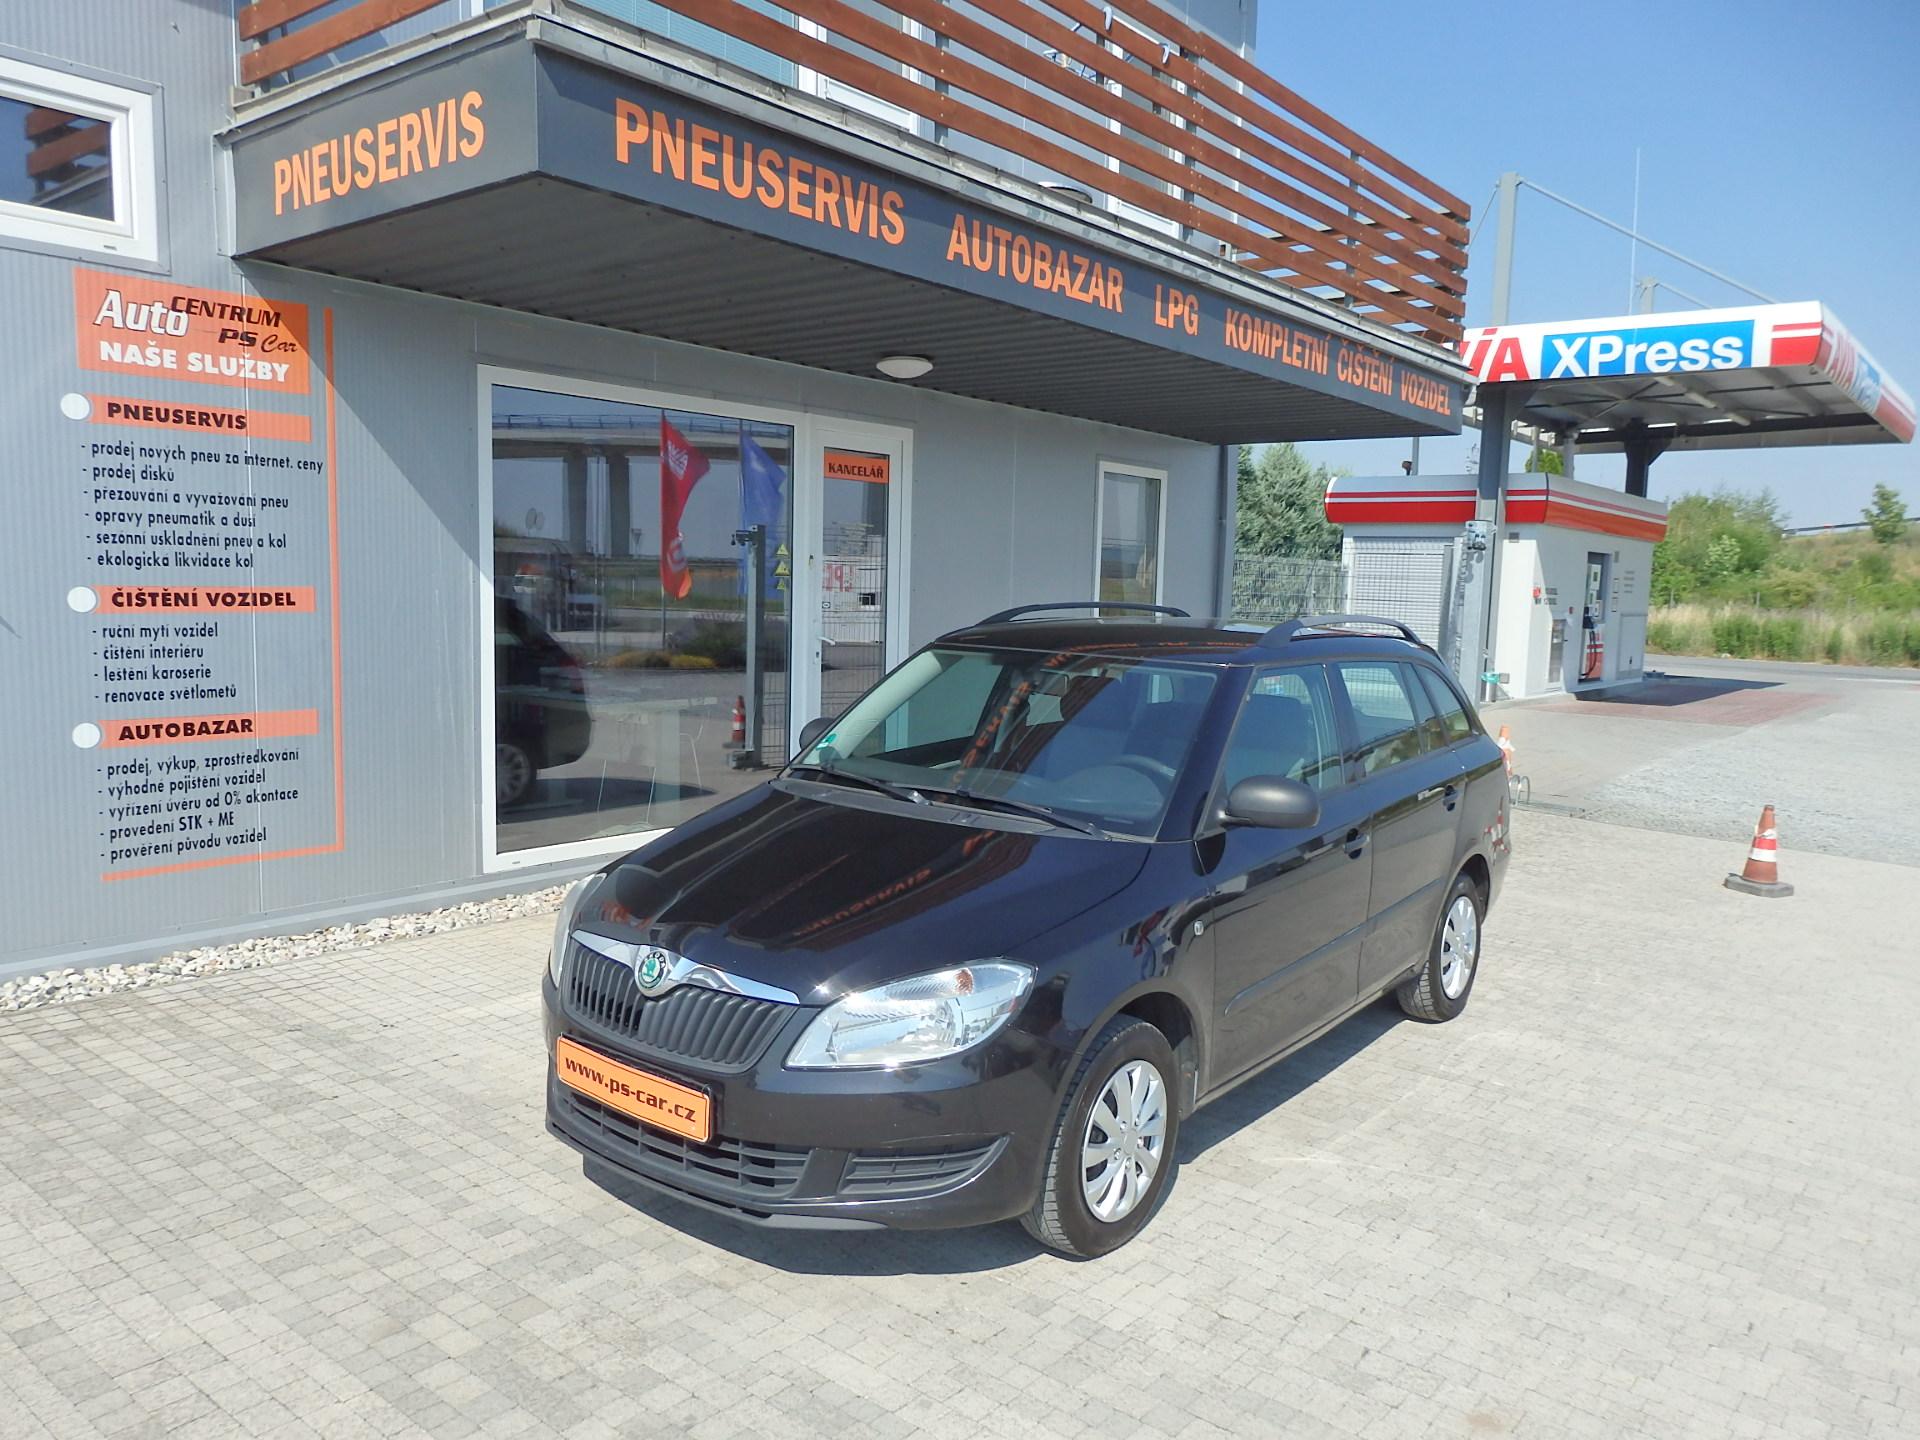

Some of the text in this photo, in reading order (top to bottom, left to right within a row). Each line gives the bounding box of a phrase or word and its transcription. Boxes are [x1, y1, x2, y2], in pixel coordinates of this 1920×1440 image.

[274, 91, 485, 215] PNEUSERVIS
[615, 97, 1451, 415] PNEUSERVIS AUTOBAZAR LPG KOMPLETNÍ ČIŠTĚNÍ VOZIDEL
[92, 288, 281, 337] Auto CENTRUM
[218, 328, 299, 353] PS Car
[99, 339, 290, 382] NAŠE SLUŽBY
[1550, 335, 1744, 379] XPress
[107, 402, 247, 430] PNEUSERVIS
[92, 440, 134, 460] prodej
[191, 451, 220, 465] pneu
[225, 454, 240, 464] za
[244, 450, 294, 469] internet.
[297, 459, 324, 475] ceny
[93, 463, 135, 483] prodej
[828, 461, 884, 479] KANCELÁŘ
[173, 493, 181, 503] a
[261, 497, 289, 510] pneu
[95, 511, 142, 527] opravy
[148, 510, 216, 528] pneumatik
[221, 516, 228, 526] a
[224, 536, 253, 550] pneu
[257, 538, 264, 548] a
[268, 533, 286, 548] kol
[97, 549, 253, 570] ekologická likvidace kol
[111, 588, 296, 607] ČIŠTĚNÍ VOZIDEL
[102, 624, 135, 639] ruční
[174, 622, 218, 638] vozidel
[152, 664, 211, 679] karoserie
[105, 690, 165, 703] renovace
[119, 718, 254, 741] AUTOBAZAR
[107, 758, 152, 780] prodej,
[224, 768, 266, 786] vozidel
[206, 792, 220, 808] od
[224, 790, 242, 806] 0%
[246, 788, 299, 804] akontace
[110, 819, 175, 844] provedení
[179, 814, 204, 831] STK
[218, 811, 235, 827] ME
[177, 833, 221, 855] původu
[225, 826, 267, 846] vozidel
[565, 1056, 697, 1123] www.ps-car.cz
